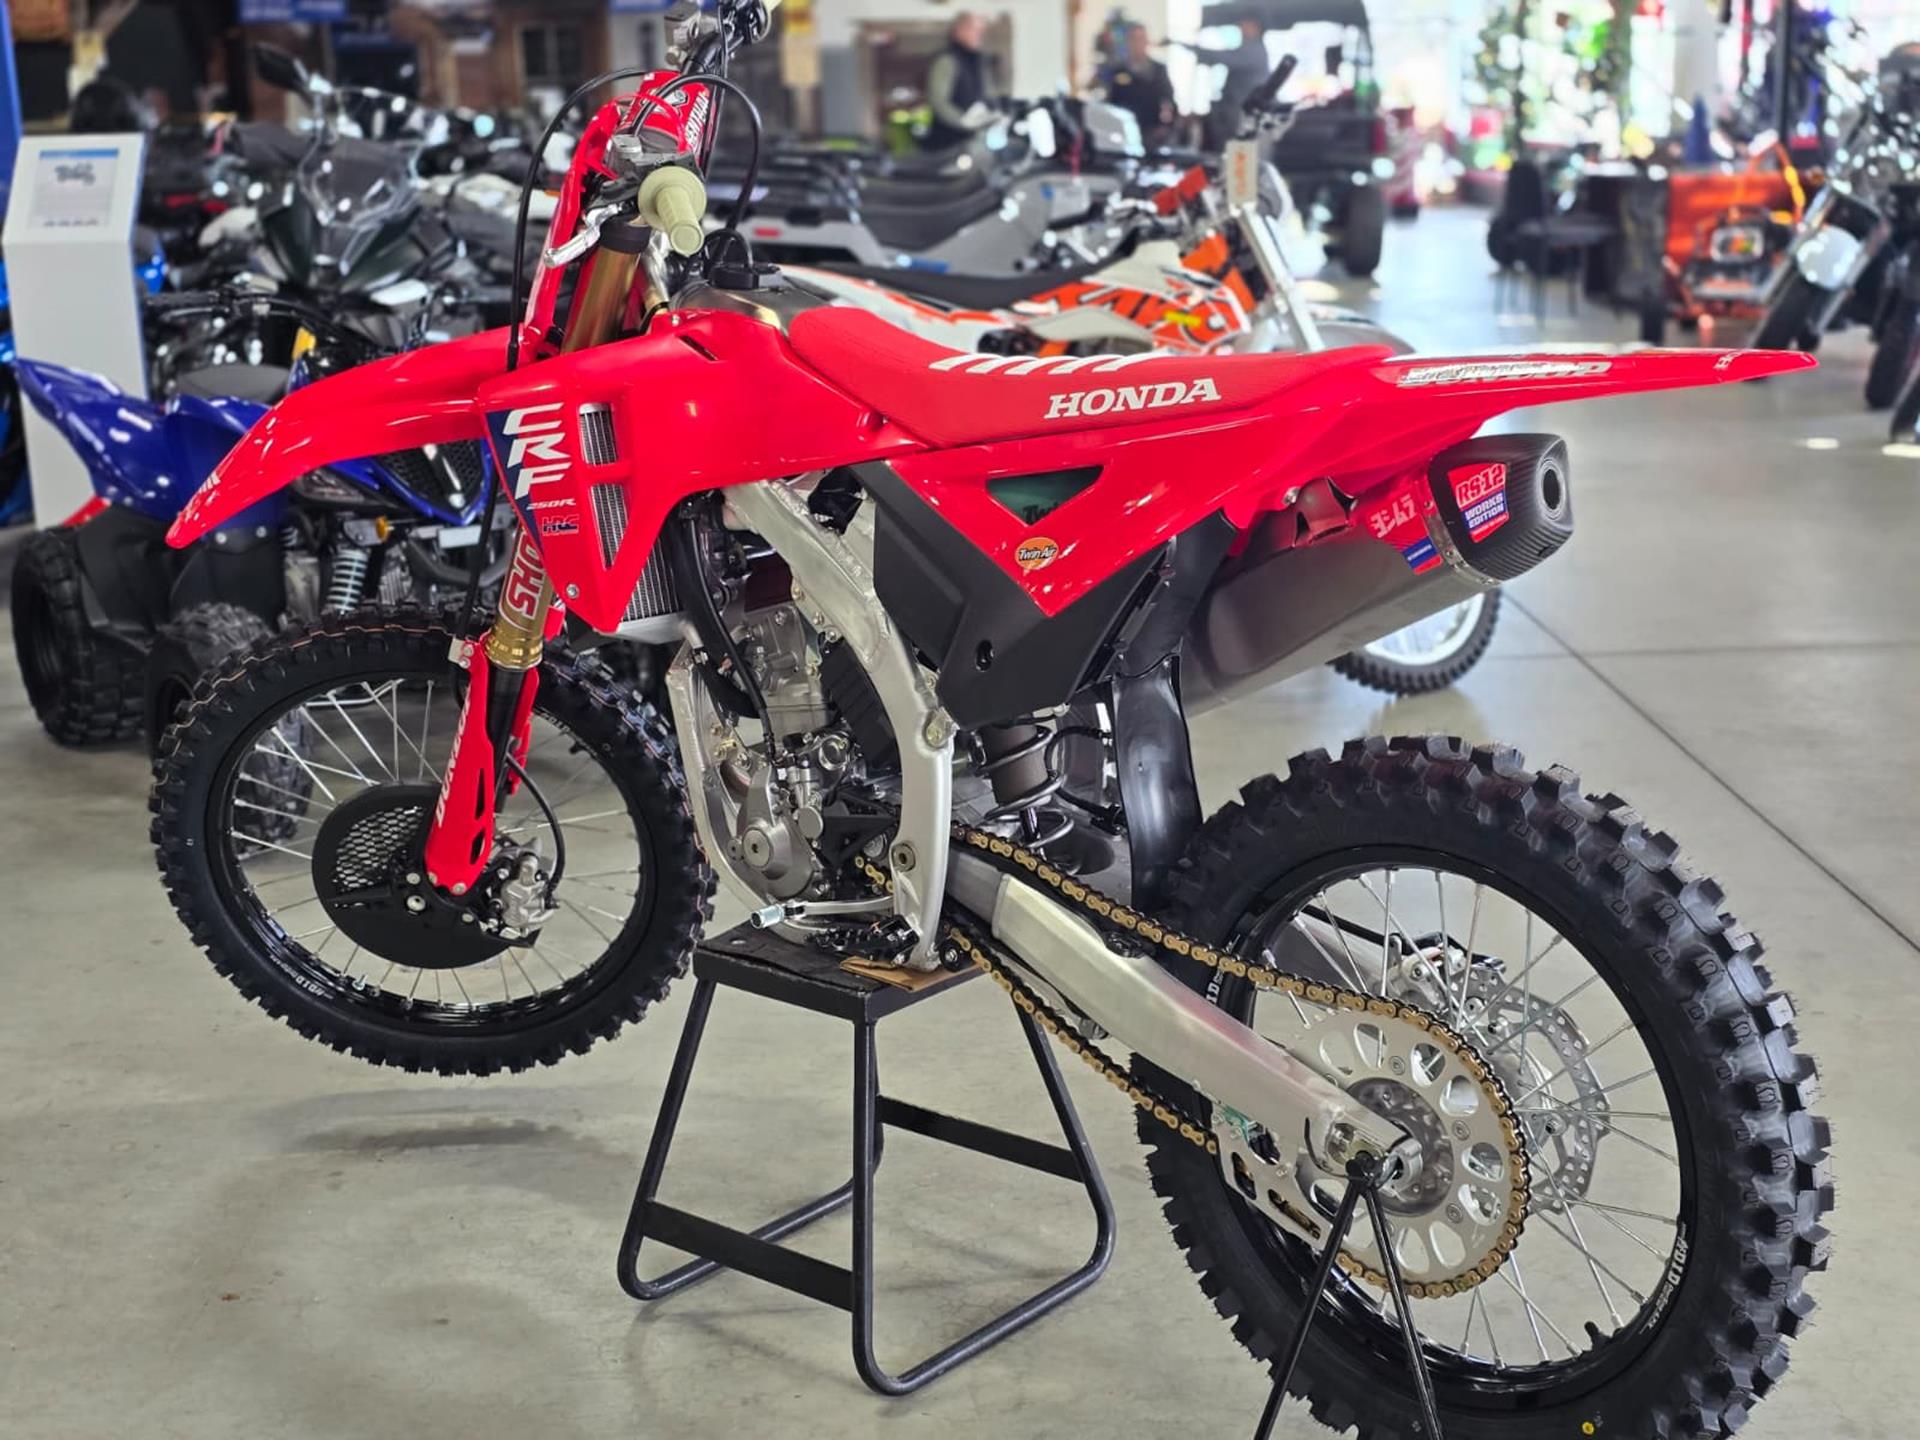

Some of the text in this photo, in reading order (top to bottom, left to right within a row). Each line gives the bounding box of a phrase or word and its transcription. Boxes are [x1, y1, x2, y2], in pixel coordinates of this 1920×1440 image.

[1044, 378, 1221, 419] HONDA
[502, 402, 572, 500] CRF
[526, 498, 577, 511] 250R
[1370, 493, 1417, 538] ヨシムラ
[1464, 492, 1504, 521] WORKS
[1468, 502, 1505, 529] EDITION
[542, 514, 580, 537] HRC
[1018, 544, 1057, 561] Twin Air
